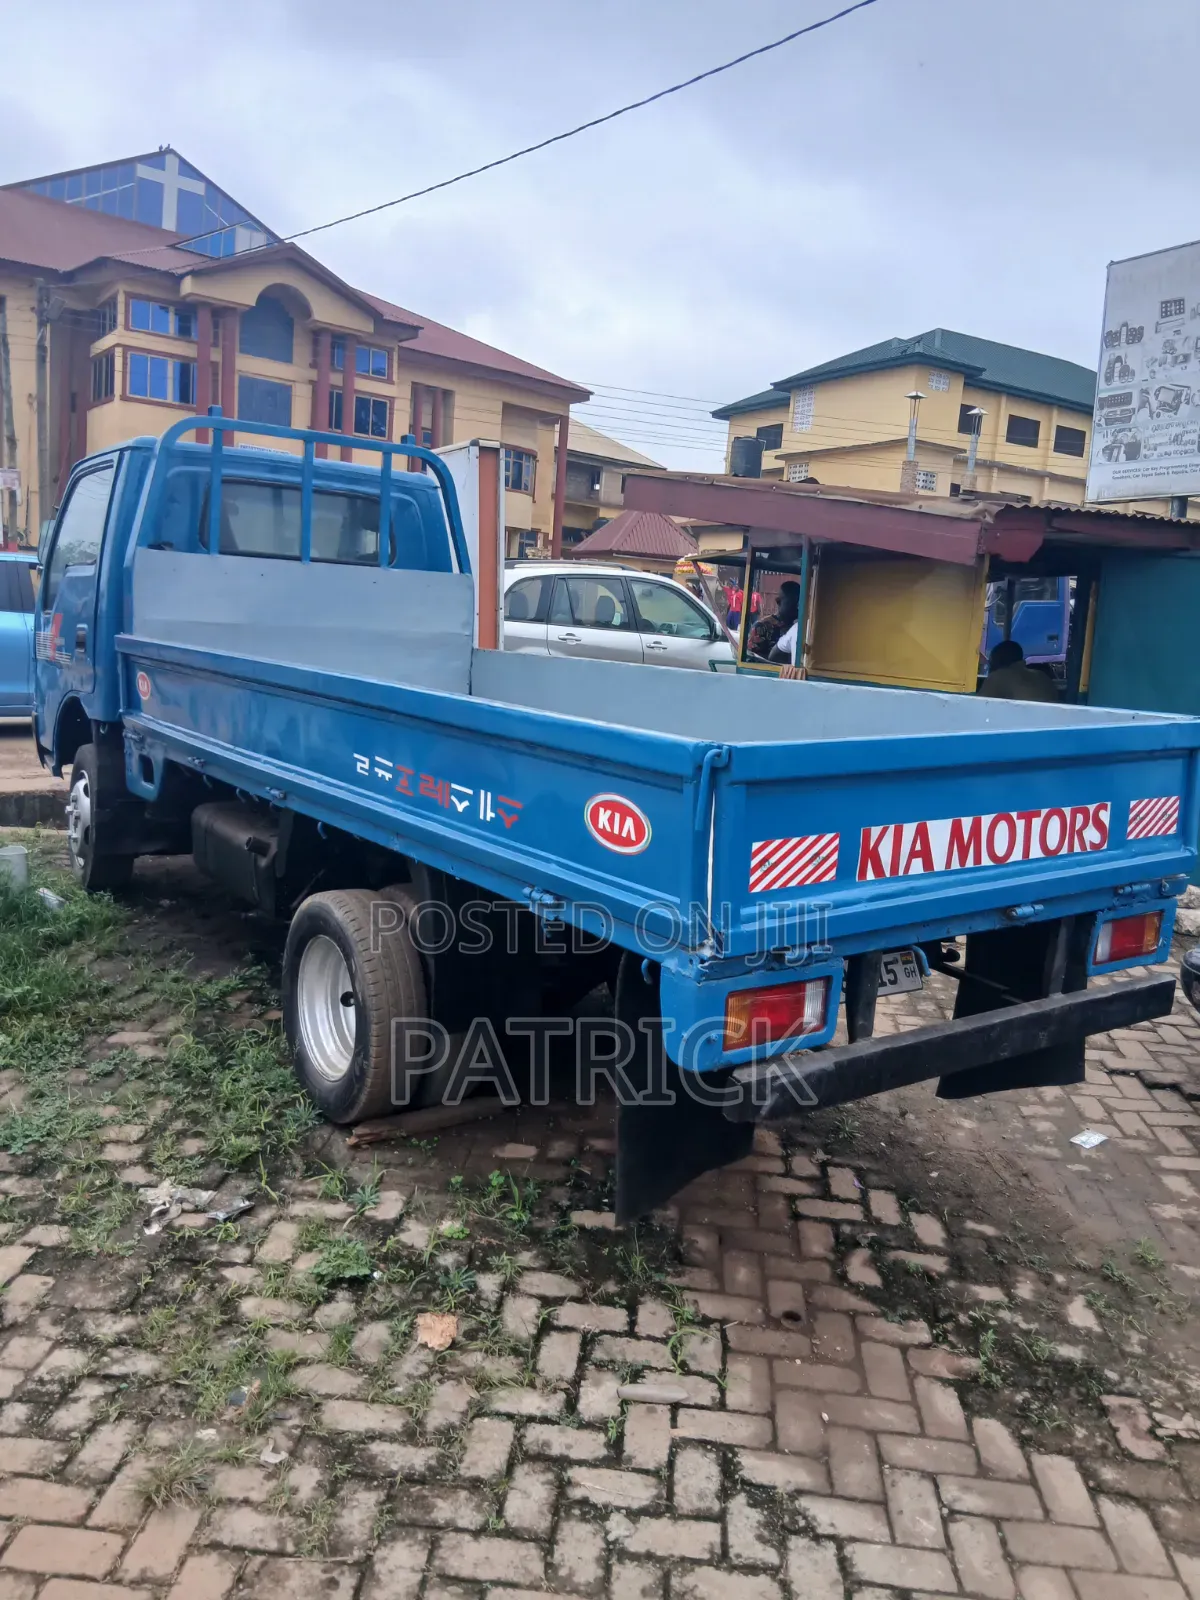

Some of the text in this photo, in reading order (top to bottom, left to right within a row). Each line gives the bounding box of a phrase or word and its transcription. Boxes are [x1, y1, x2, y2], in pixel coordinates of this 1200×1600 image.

[597, 807, 637, 841] KIA
[857, 802, 1109, 881] KIA MOTORS
[903, 966, 917, 978] GH
